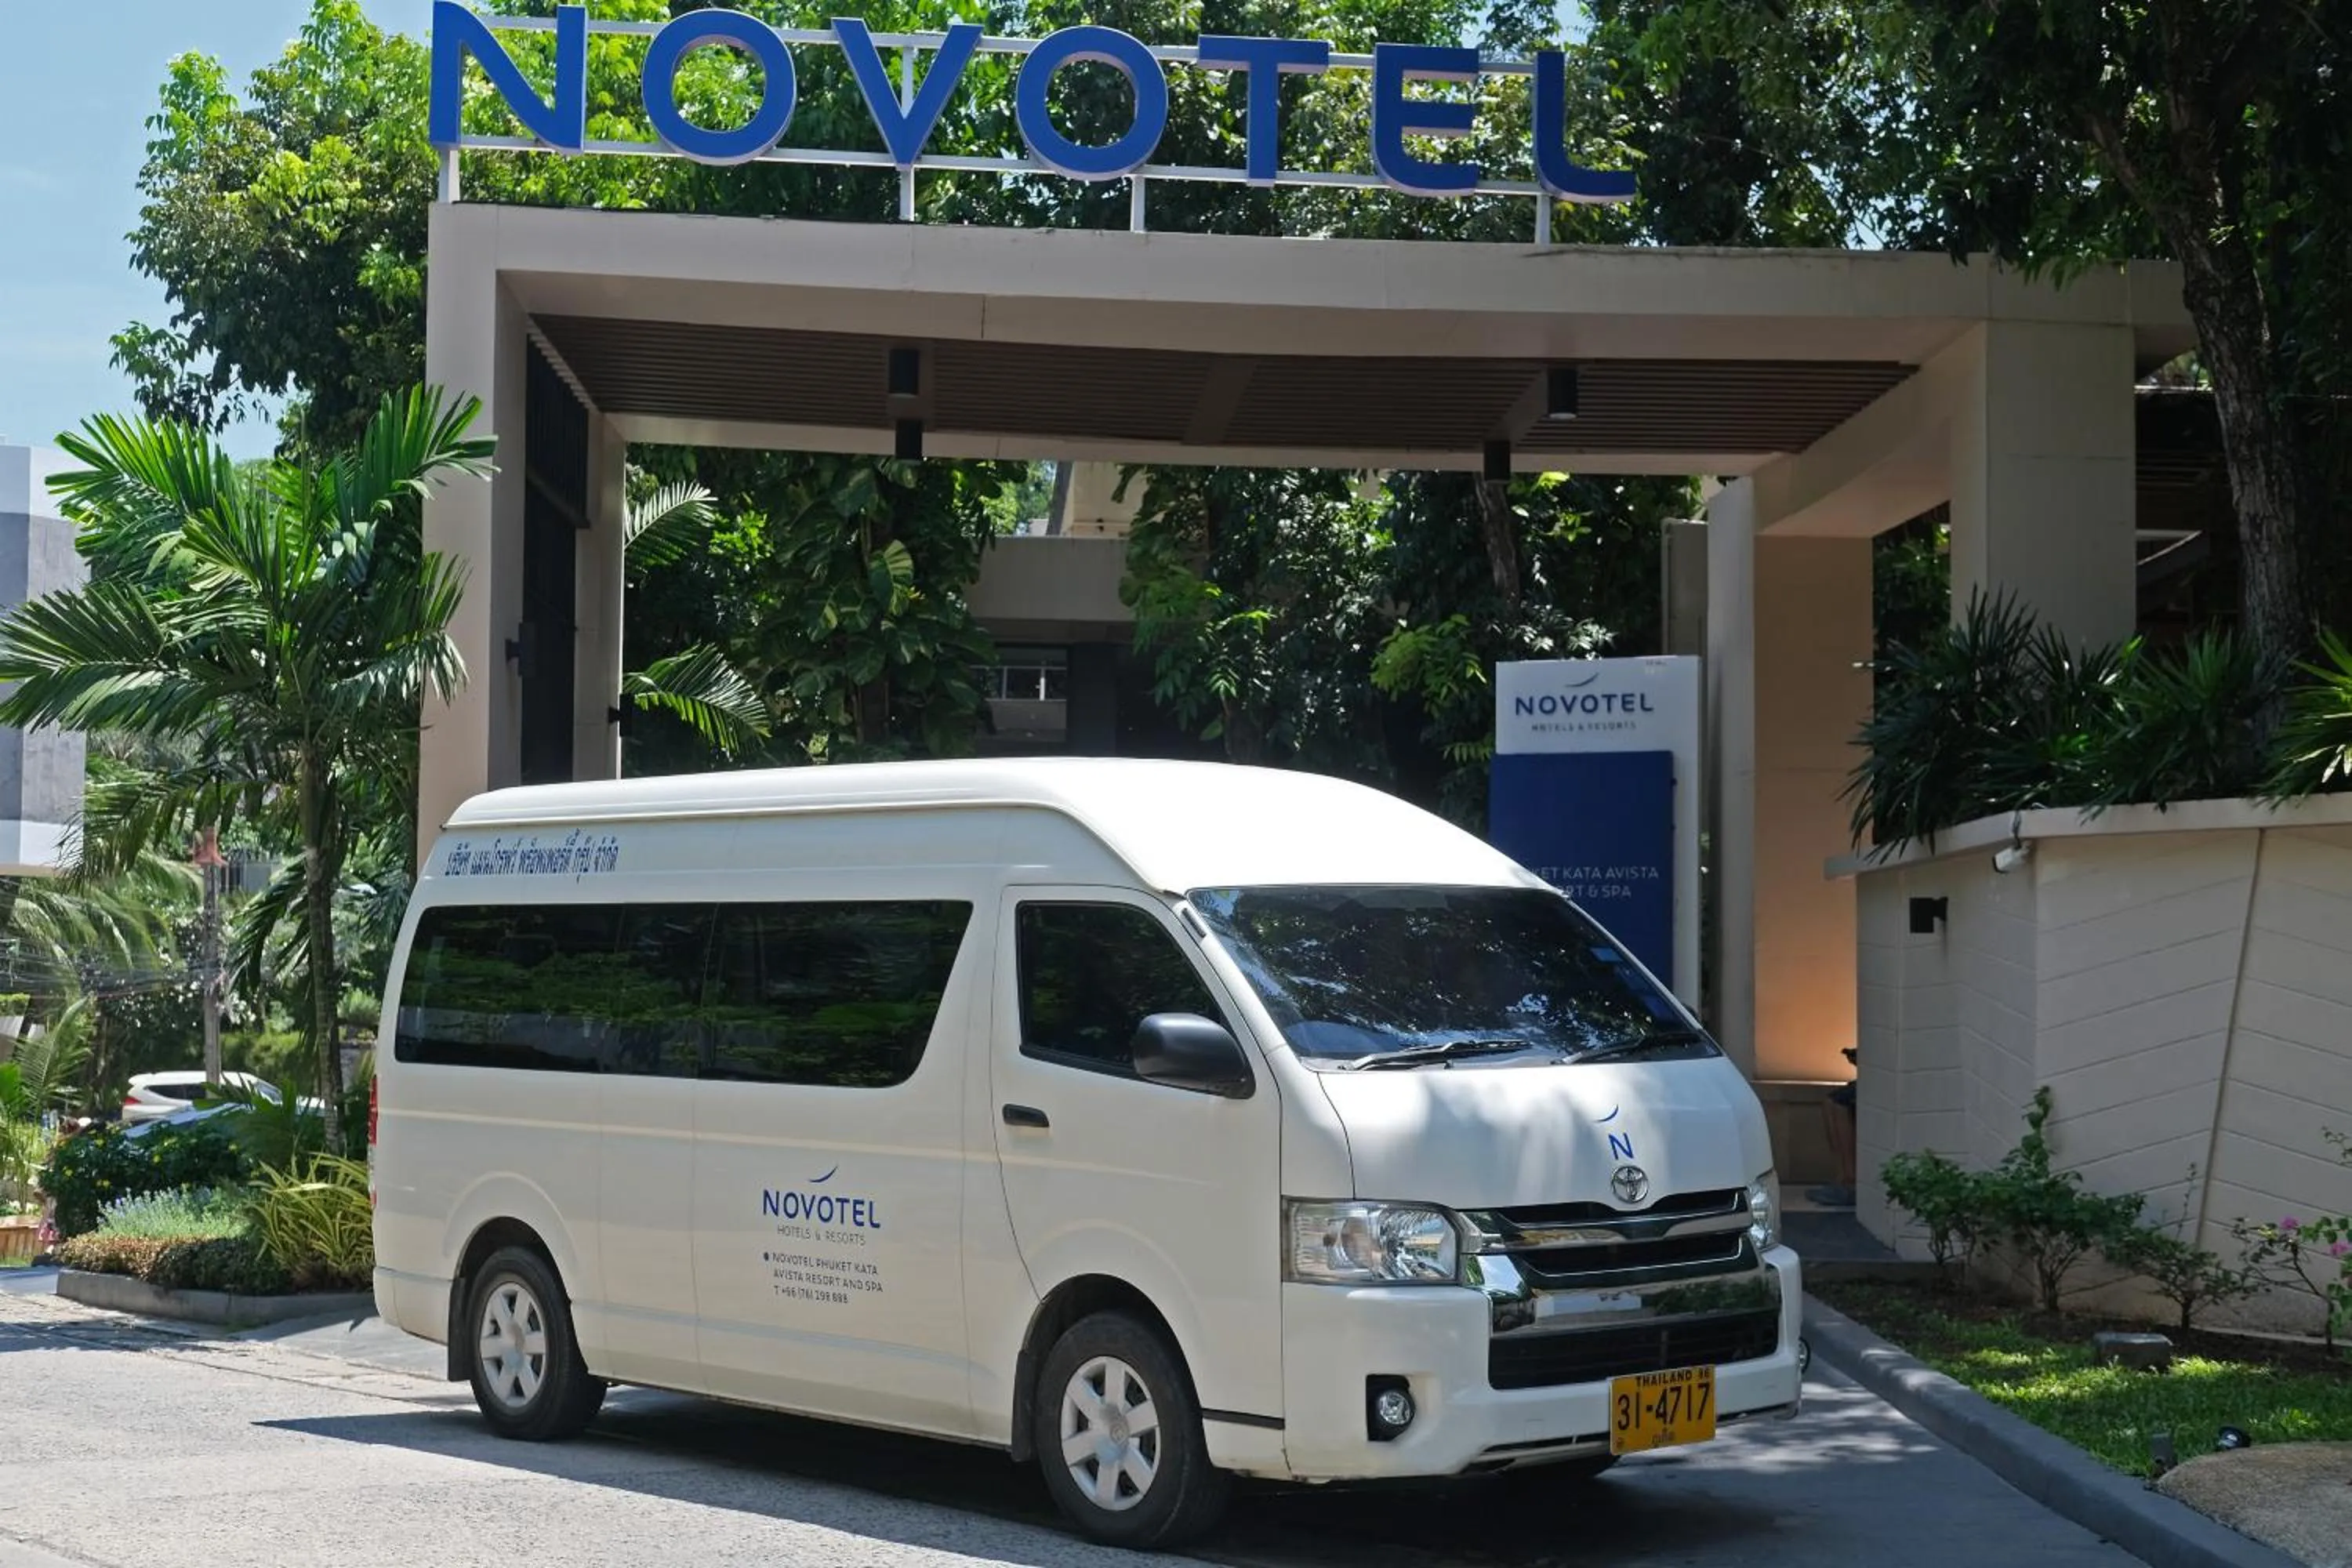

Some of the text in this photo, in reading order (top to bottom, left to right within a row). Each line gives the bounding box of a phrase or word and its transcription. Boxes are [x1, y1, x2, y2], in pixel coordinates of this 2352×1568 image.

[430, 2, 1636, 204] NOVOTEL
[1515, 693, 1655, 716] NOVOTEL
[445, 842, 470, 876] บริษัท
[1563, 866, 1602, 880] KATA
[1604, 866, 1660, 880] AVISTA
[1588, 885, 1599, 898] &
[1602, 885, 1632, 898] SPA
[1608, 1131, 1634, 1160] N
[763, 1189, 881, 1229] NOVOTEL
[777, 1225, 811, 1240] HOTELS
[826, 1230, 866, 1246] RESORTS
[772, 1252, 879, 1276] NOVOTEL PHUKET KATA
[773, 1268, 884, 1294] AVISTA RESORT AND SPA
[1635, 1369, 1693, 1387] THAILAND
[1617, 1382, 1711, 1431] 31-4717
